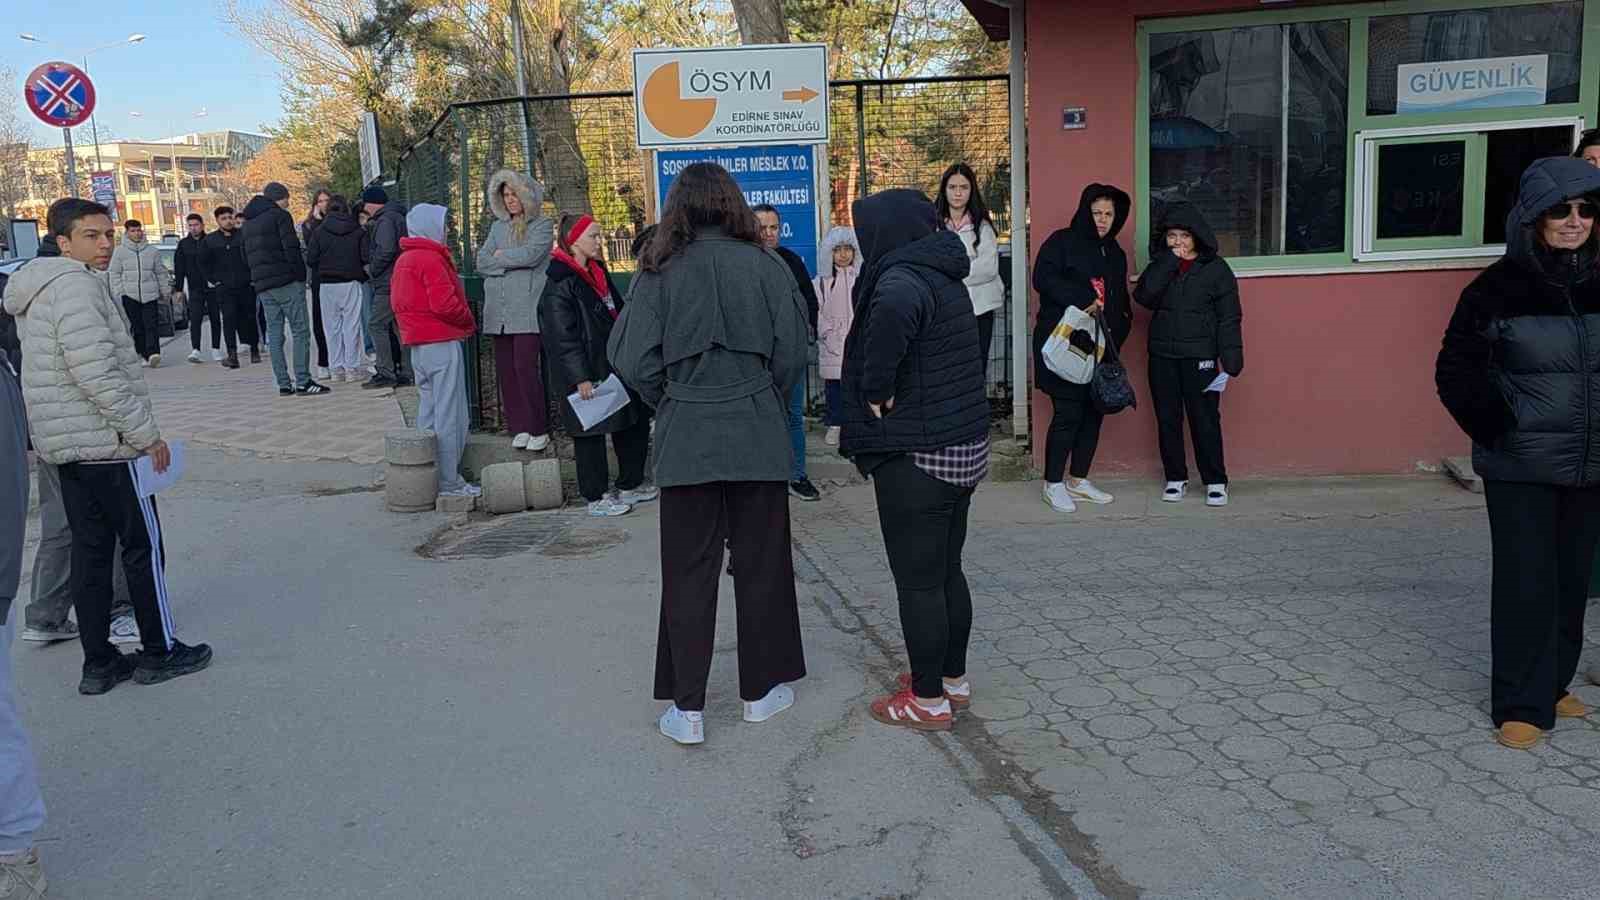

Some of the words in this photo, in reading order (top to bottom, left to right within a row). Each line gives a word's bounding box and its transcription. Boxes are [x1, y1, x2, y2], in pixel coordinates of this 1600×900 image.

[690, 69, 771, 93] ÖSYM
[1410, 62, 1534, 93] GÜVENLİK
[732, 110, 770, 122] EDİRNE
[773, 110, 804, 121] SINAV
[716, 120, 820, 135] KOORDİNATÖRLÜĞÜ
[663, 158, 700, 177] SOSY
[750, 156, 789, 172] MESLEK
[764, 184, 809, 206] FAKÜLTESİ
